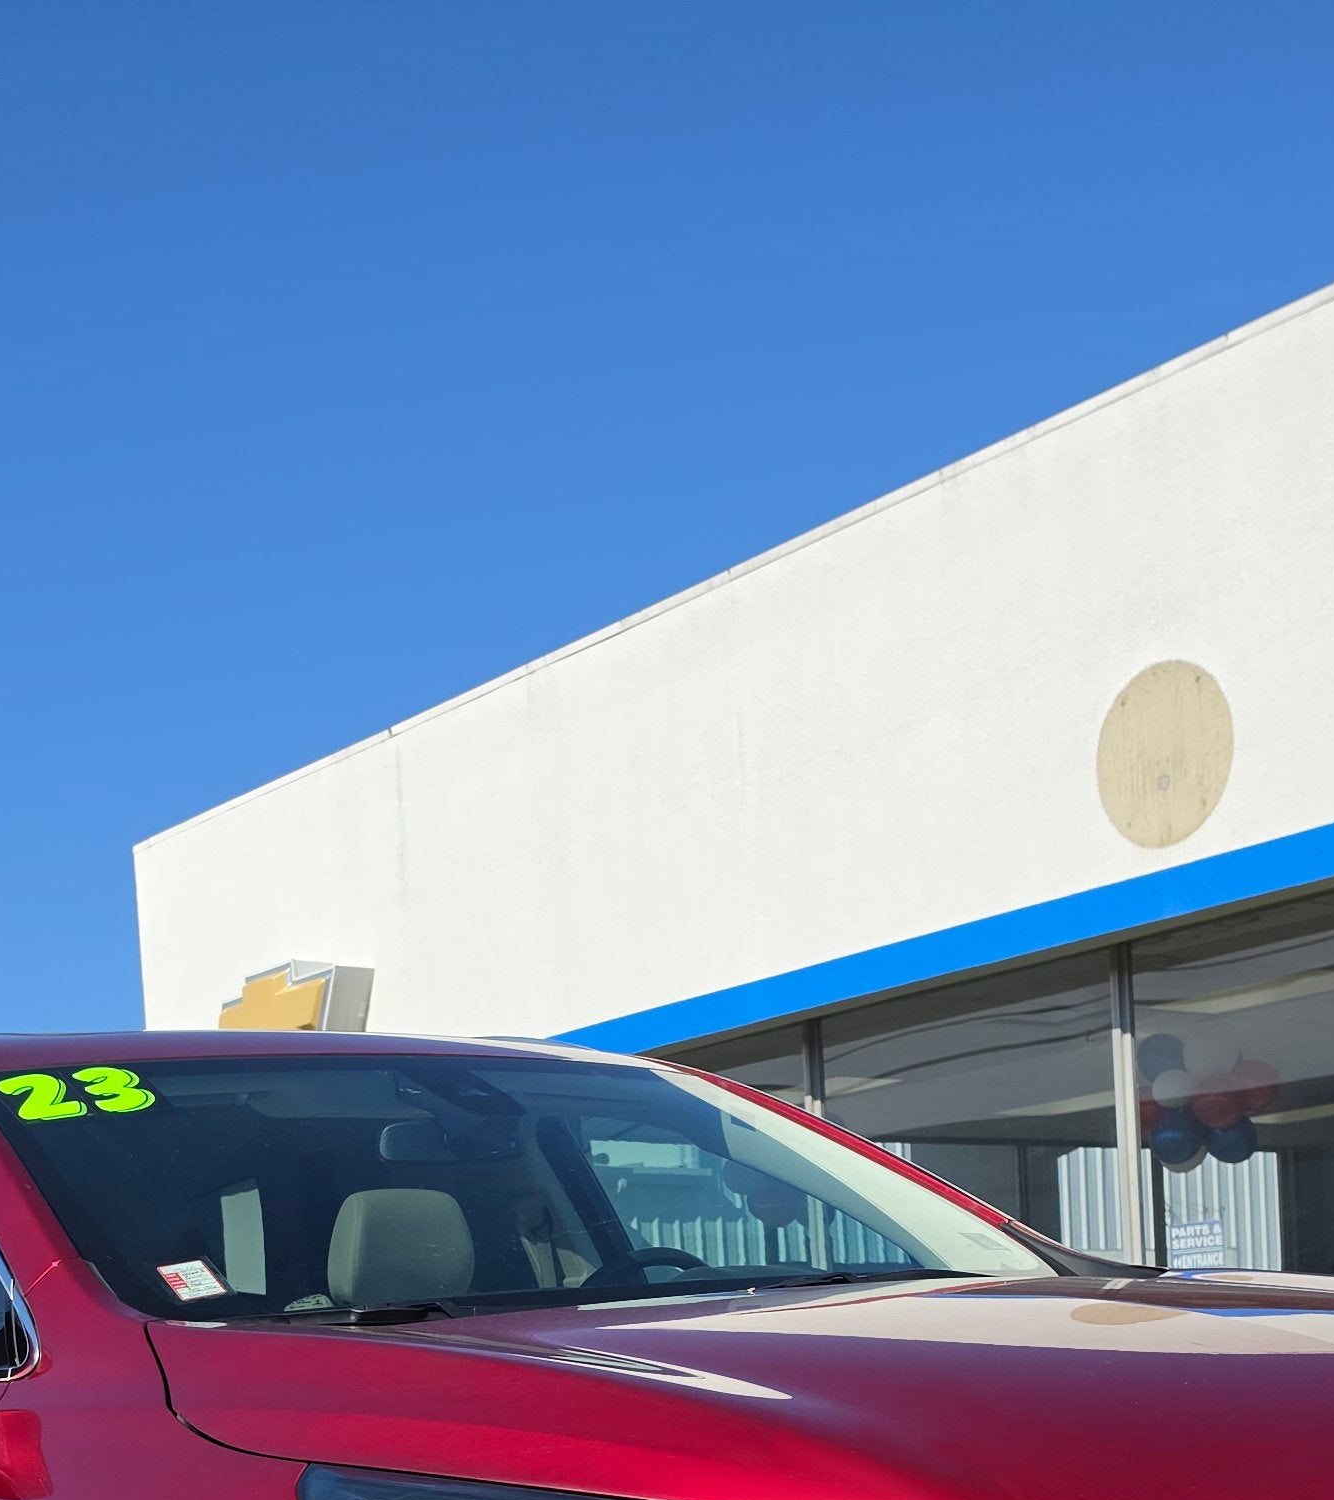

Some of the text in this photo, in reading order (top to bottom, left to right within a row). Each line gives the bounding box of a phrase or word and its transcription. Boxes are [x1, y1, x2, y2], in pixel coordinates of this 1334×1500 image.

[1171, 1222, 1222, 1239] PARTS &
[1172, 1234, 1223, 1250] SERVICE
